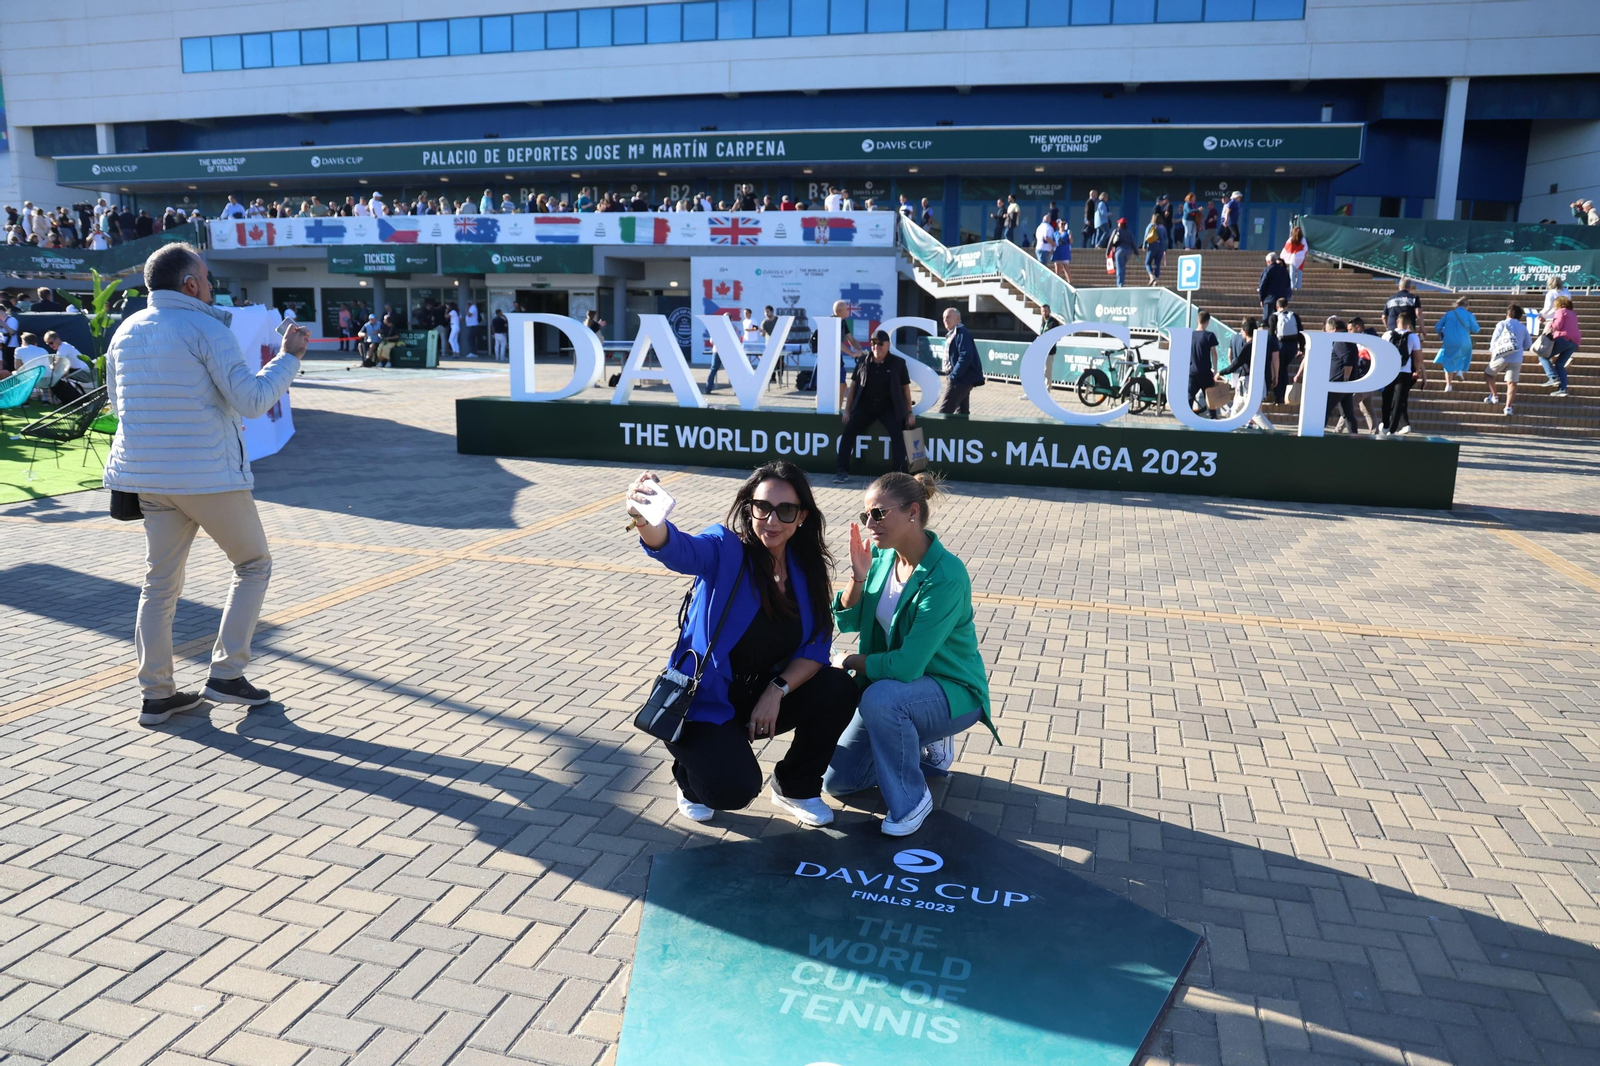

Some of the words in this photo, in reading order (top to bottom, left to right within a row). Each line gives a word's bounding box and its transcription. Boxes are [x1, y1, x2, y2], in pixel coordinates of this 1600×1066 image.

[876, 140, 906, 150] DAVIS
[909, 140, 932, 149] CUP
[1029, 135, 1047, 144] THE
[1049, 135, 1081, 144] WORLD
[1083, 135, 1102, 143] CUP
[1041, 144, 1053, 152] OF
[1055, 144, 1088, 152] TENNIS
[1220, 139, 1254, 148] DAVIS
[1257, 139, 1283, 148] CUP
[322, 157, 345, 165] DAVIS
[422, 150, 478, 166] PALACIO
[484, 148, 500, 164] DE
[507, 146, 578, 163] DEPORTES
[585, 144, 620, 160] JOSE
[652, 139, 708, 159] MARTÍN
[716, 140, 786, 157] CARPENA
[671, 185, 690, 200] B2
[364, 253, 395, 264] TICKETS
[1508, 266, 1526, 274] THE
[1528, 266, 1560, 274] WORLD
[1104, 307, 1122, 315] DAVIS
[1123, 307, 1138, 315] CUP
[506, 312, 942, 416] DAVIS
[1020, 321, 1402, 436] CUP
[620, 422, 669, 447] THE
[675, 425, 768, 453] WORLD
[775, 431, 829, 456] CUP
[878, 436, 983, 464] TNNIS
[1006, 437, 1133, 472] MÁLAGA
[1142, 449, 1218, 477] 2023
[794, 861, 920, 892] DAVIS
[934, 883, 1030, 907] CUP
[851, 890, 912, 906] FINALS
[914, 900, 955, 913] 2023
[856, 915, 942, 948] THE
[808, 934, 972, 980] WORLD
[791, 961, 892, 995] CUP
[900, 980, 966, 1008] OF
[778, 987, 960, 1044] TENNIS
